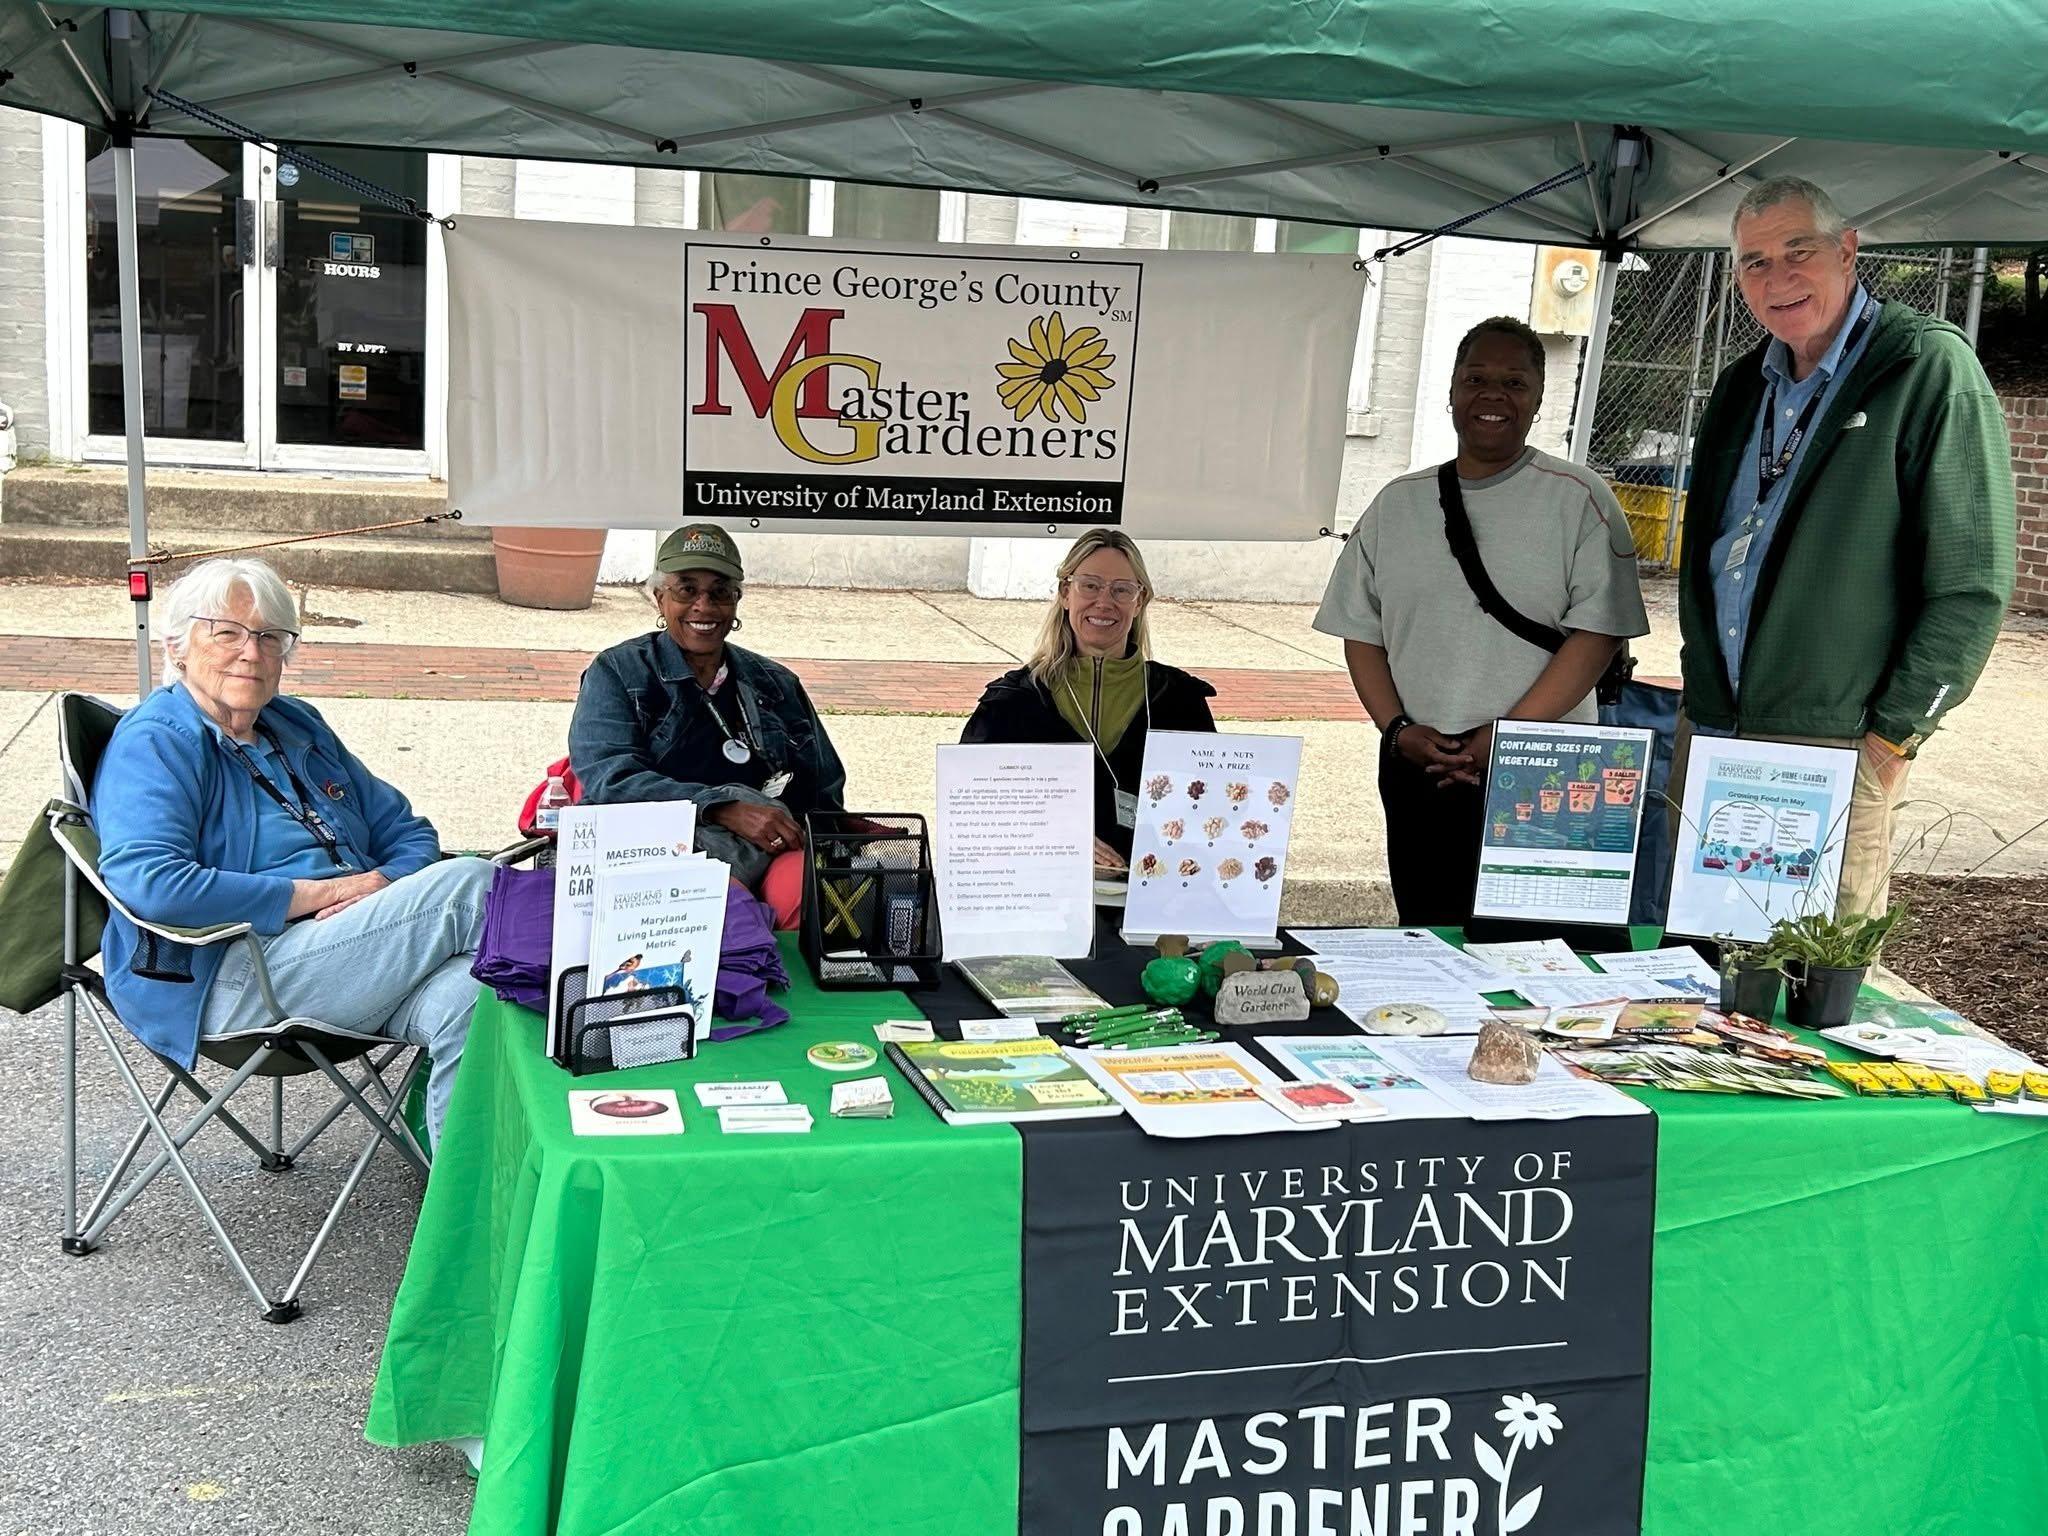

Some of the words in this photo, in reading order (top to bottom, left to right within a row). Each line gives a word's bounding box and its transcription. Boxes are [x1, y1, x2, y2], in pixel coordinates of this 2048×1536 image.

[324, 263, 380, 278] HOURS
[706, 260, 821, 297] Prince
[832, 266, 984, 309] George's
[994, 273, 1121, 316] County
[1111, 309, 1133, 323] SM
[337, 342, 353, 352] BY
[691, 302, 969, 421] Master
[770, 353, 1117, 465] Gardeners
[695, 482, 828, 513] University
[834, 485, 862, 509] of
[866, 488, 985, 517] Maryland
[991, 490, 1113, 514] Extension
[1500, 740, 1552, 752] CONTAINER
[1555, 743, 1581, 753] SIZES
[1583, 744, 1602, 754] FOR
[1234, 751, 1254, 759] NUTS
[1498, 755, 1559, 767] VEGETABLES
[1728, 791, 1758, 802] Growing
[1760, 794, 1780, 803] Food
[1790, 797, 1806, 807] May
[606, 846, 667, 860] MAESTROS
[570, 864, 596, 877] MA
[641, 912, 688, 926] Maryland
[617, 931, 647, 942] Living
[649, 924, 708, 937] Landscapes
[645, 939, 677, 950] Metric
[1234, 984, 1267, 997] World
[1270, 983, 1296, 995] Class
[1240, 1000, 1290, 1013] Gardener
[1120, 1155, 1485, 1212] UNIVERSITY
[1514, 1151, 1572, 1182] OF
[1112, 1186, 1575, 1277] MARYLAND
[1109, 1256, 1573, 1337] EXTENSION
[1105, 1396, 1453, 1490] MASTER
